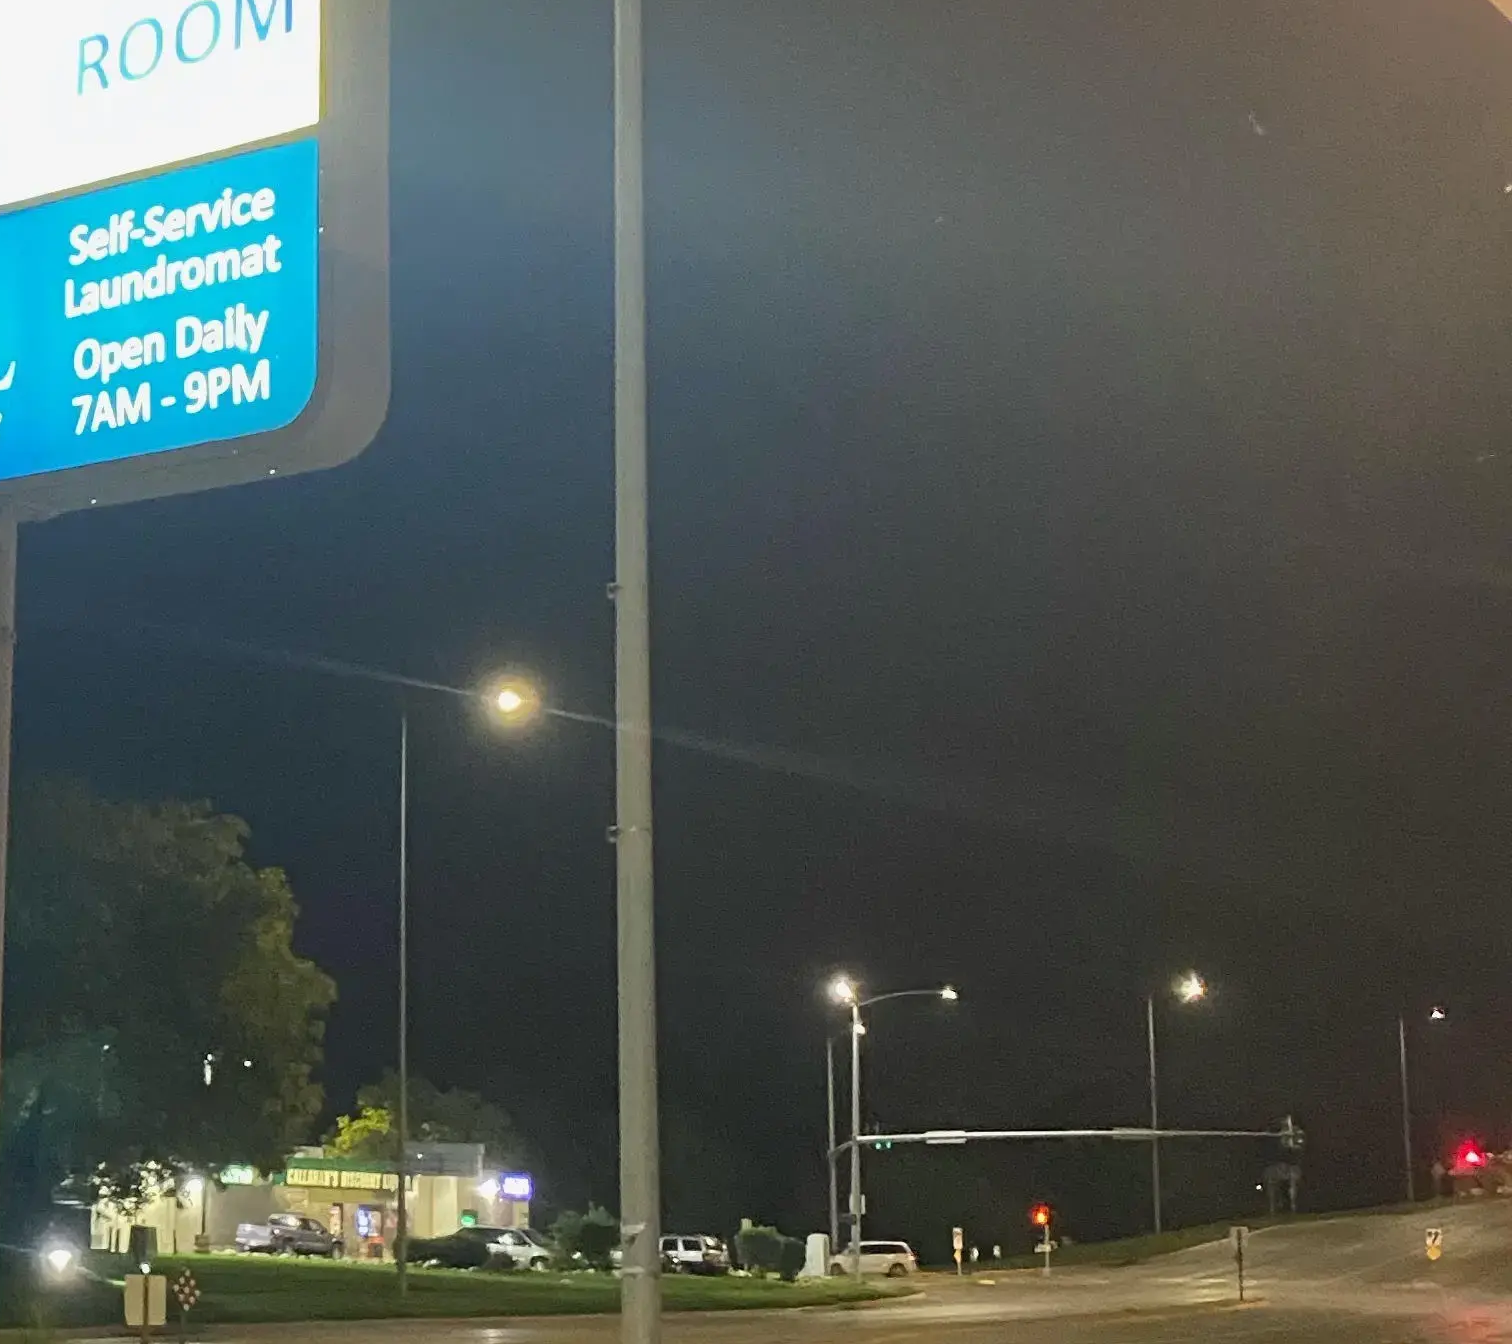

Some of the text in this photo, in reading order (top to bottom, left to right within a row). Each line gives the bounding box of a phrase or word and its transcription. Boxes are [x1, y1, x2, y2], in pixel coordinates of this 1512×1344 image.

[68, 187, 275, 266] Self-Service
[64, 234, 282, 318] Laundromat
[73, 302, 270, 384] Open Daily
[71, 358, 271, 435] 7AM - 9PM
